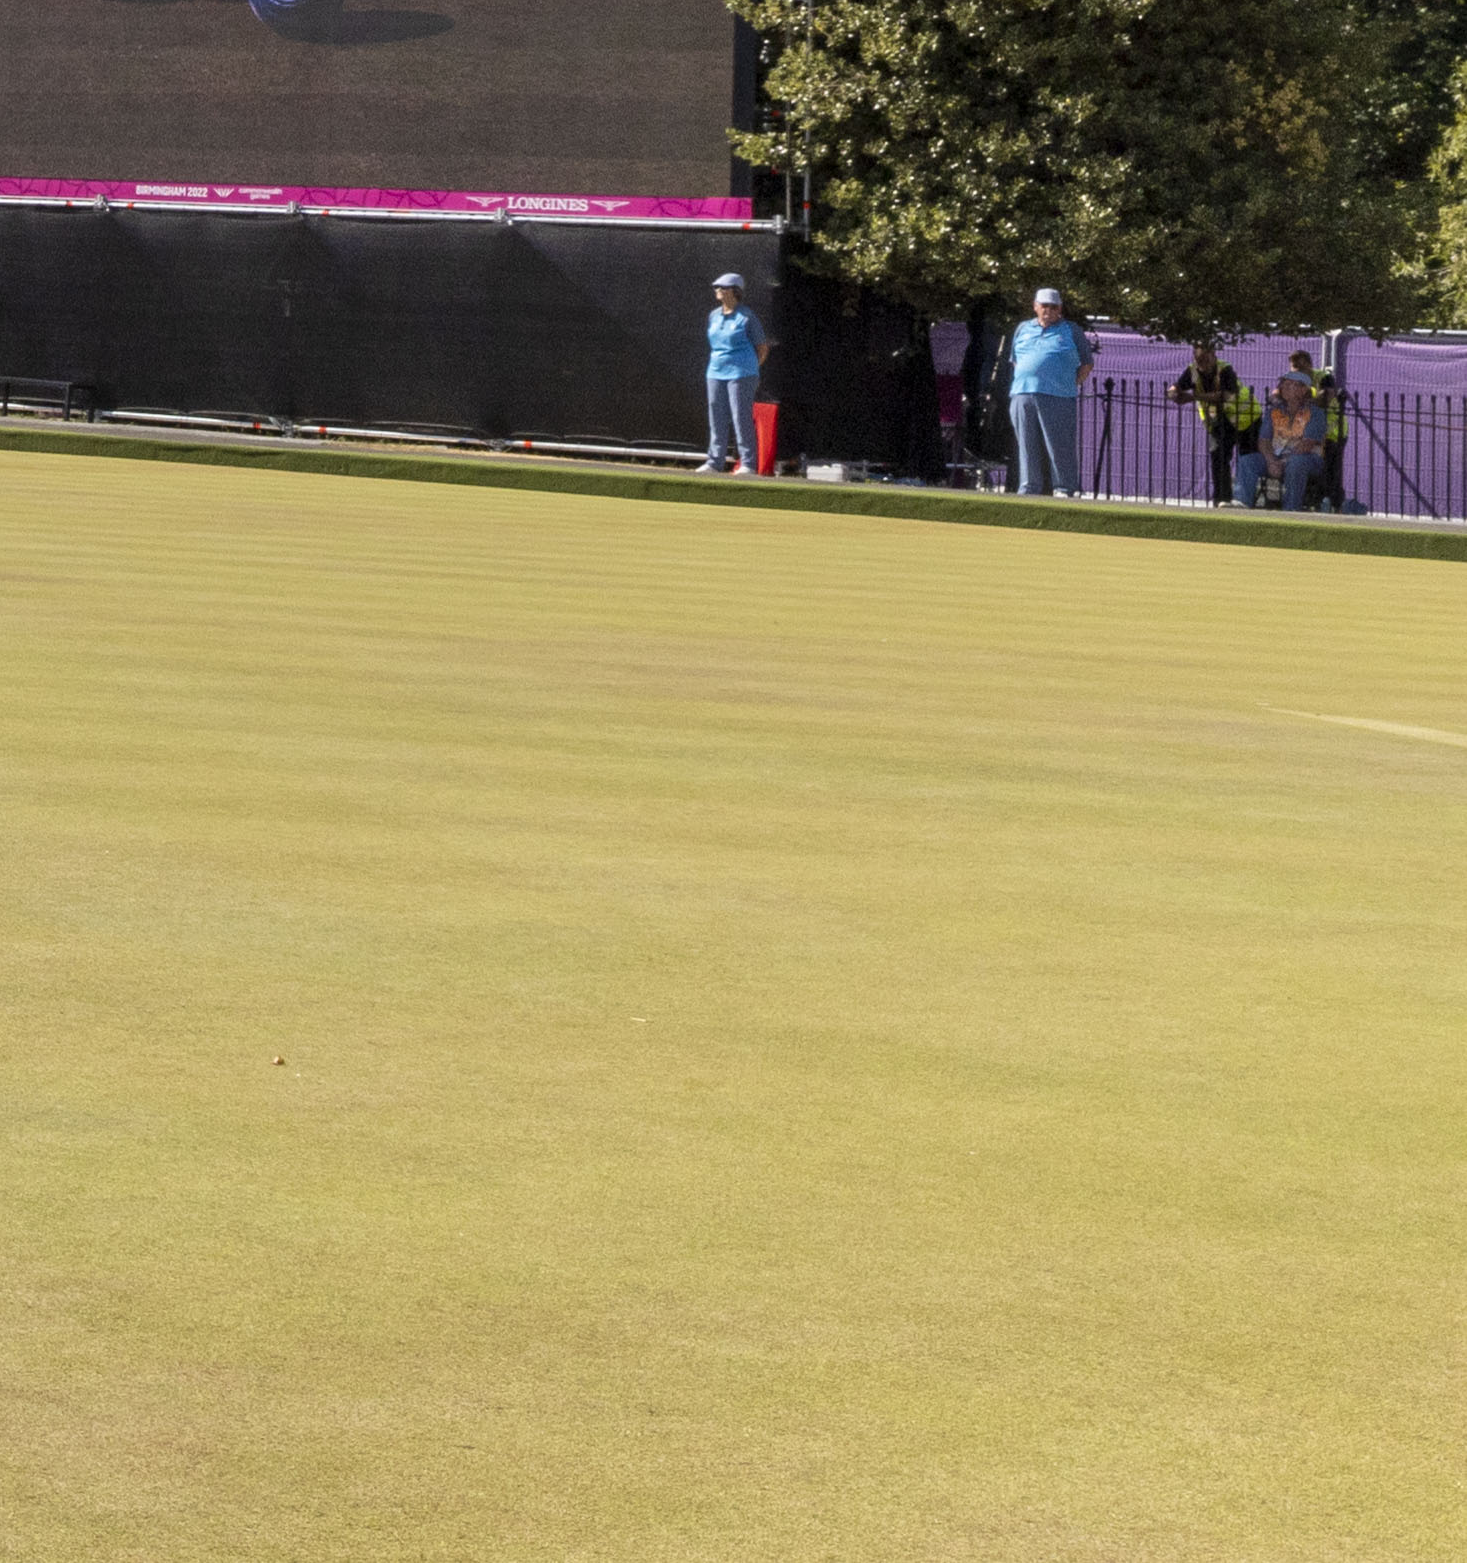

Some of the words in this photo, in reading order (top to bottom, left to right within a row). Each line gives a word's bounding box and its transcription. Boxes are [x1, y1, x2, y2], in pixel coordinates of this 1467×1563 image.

[135, 185, 186, 197] BIRMINGHAM
[187, 186, 209, 198] 2022
[507, 196, 590, 211] LONGINES
